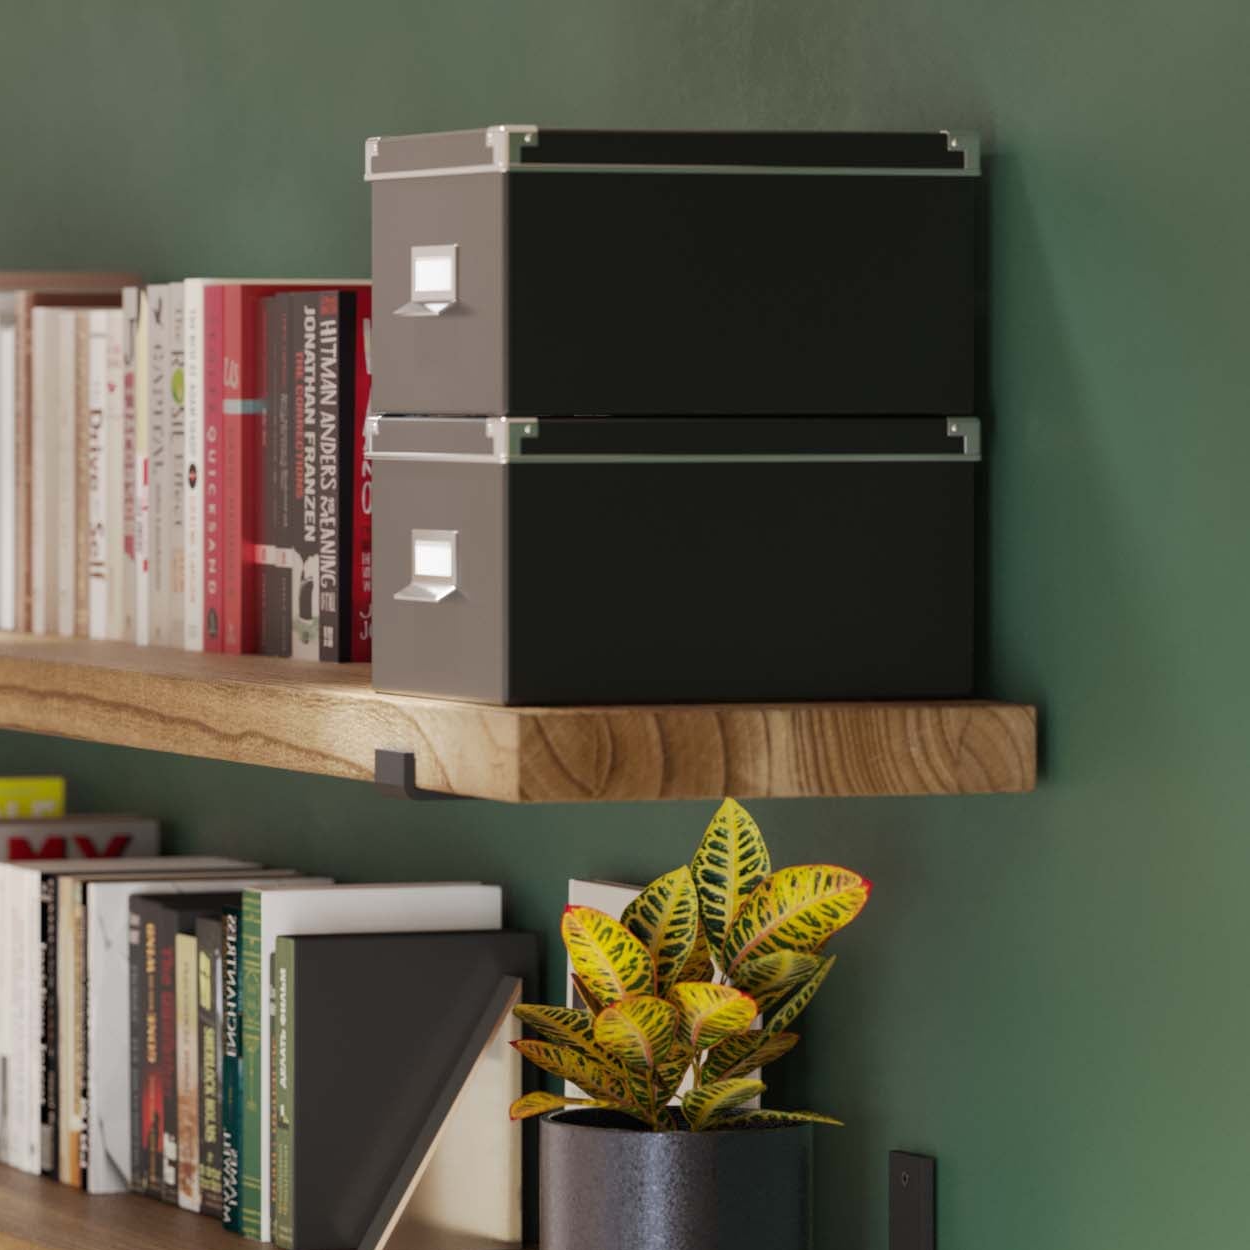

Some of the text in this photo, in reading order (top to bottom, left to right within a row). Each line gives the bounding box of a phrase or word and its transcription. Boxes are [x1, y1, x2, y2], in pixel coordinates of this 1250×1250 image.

[319, 319, 338, 405] HITMAN
[294, 351, 305, 500] THE CORRECTIONS
[303, 304, 317, 543] JONATHAN FRANZEN
[319, 411, 337, 490] ANDERS
[319, 496, 337, 589] MEANING
[279, 967, 288, 1090] ДЕЛАТЬ ФИЛЬМ
